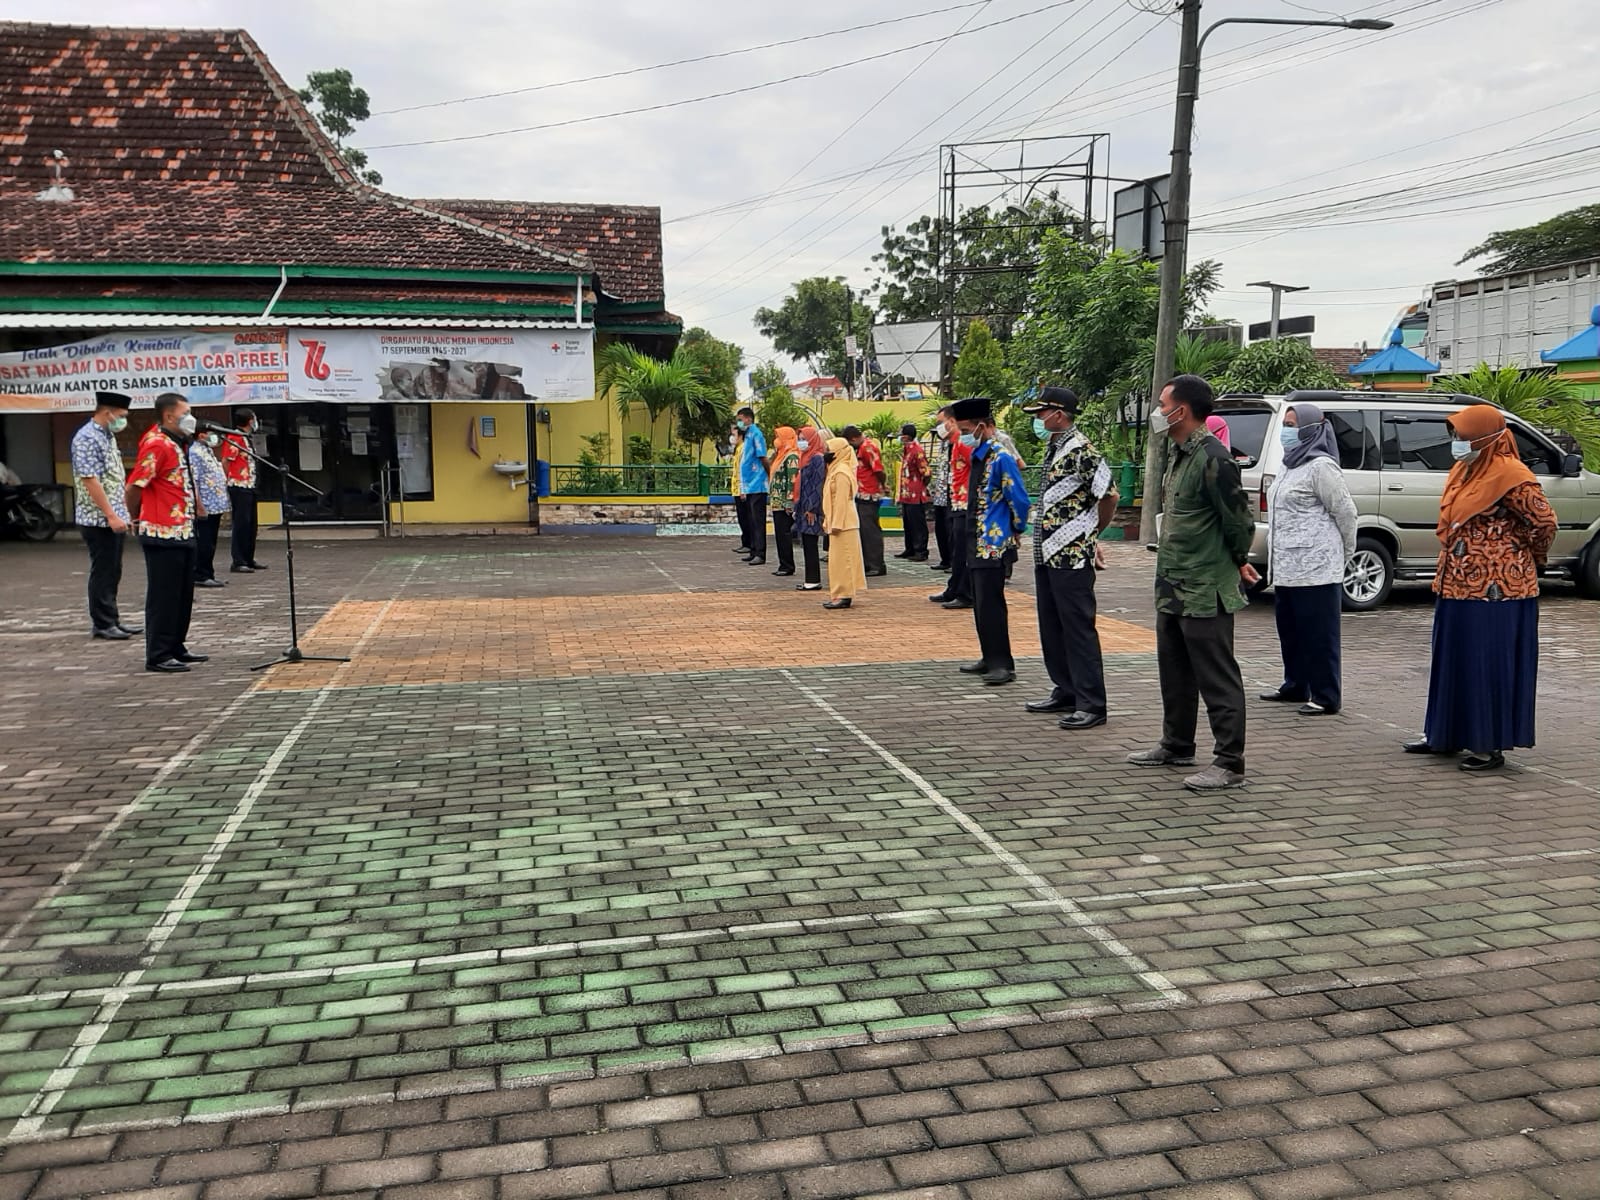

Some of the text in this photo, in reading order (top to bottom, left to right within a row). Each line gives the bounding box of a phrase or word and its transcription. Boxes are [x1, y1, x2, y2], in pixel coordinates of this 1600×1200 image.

[123, 339, 182, 353] Kembali
[381, 335, 515, 345] DIRGAHAYU PALANG MERAH INDONESIA
[382, 346, 389, 354] 17
[390, 346, 430, 354] SEPTEMBER
[35, 361, 91, 378] MALAM
[95, 357, 129, 373] DAN
[134, 354, 197, 371] SAMSAT
[202, 353, 236, 370] CAR
[239, 352, 280, 367] FREE
[0, 374, 227, 395] HALAMAN KANTOR SAMSAT DEMAK
[241, 375, 271, 384] SAMSAT
